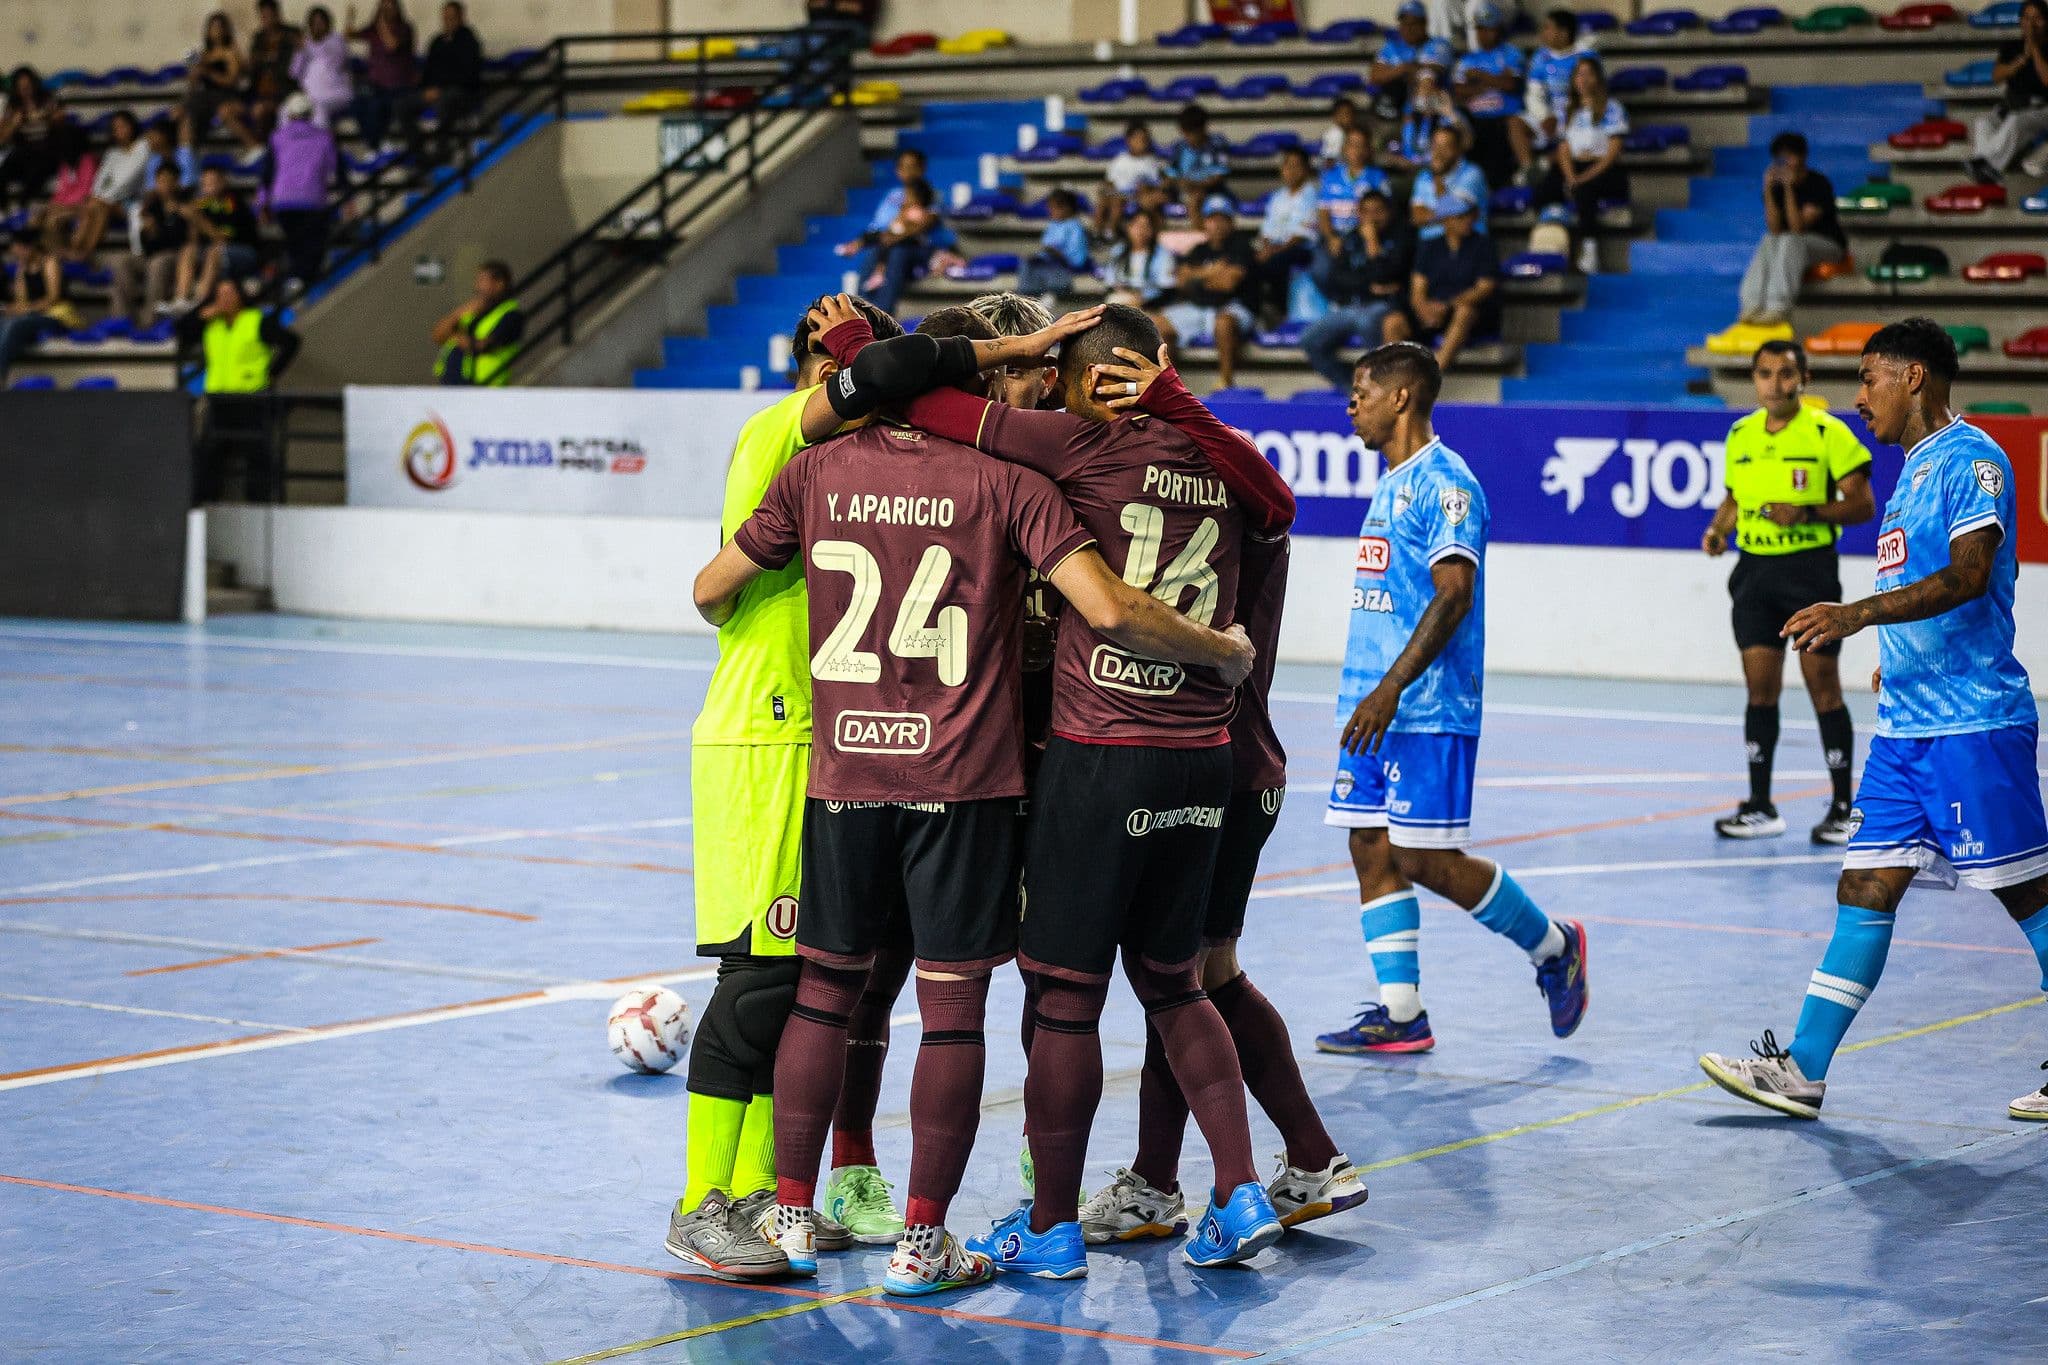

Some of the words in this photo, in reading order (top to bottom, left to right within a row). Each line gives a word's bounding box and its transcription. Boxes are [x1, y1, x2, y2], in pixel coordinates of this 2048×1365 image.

[1143, 465, 1228, 509] PORTILLA
[827, 493, 843, 522] Y.
[847, 494, 955, 528] APARICIO
[1120, 503, 1220, 627] 16
[811, 540, 968, 687] 24
[1100, 654, 1177, 687] DAYR
[843, 719, 924, 746] DAYR
[1950, 801, 1962, 824] 7
